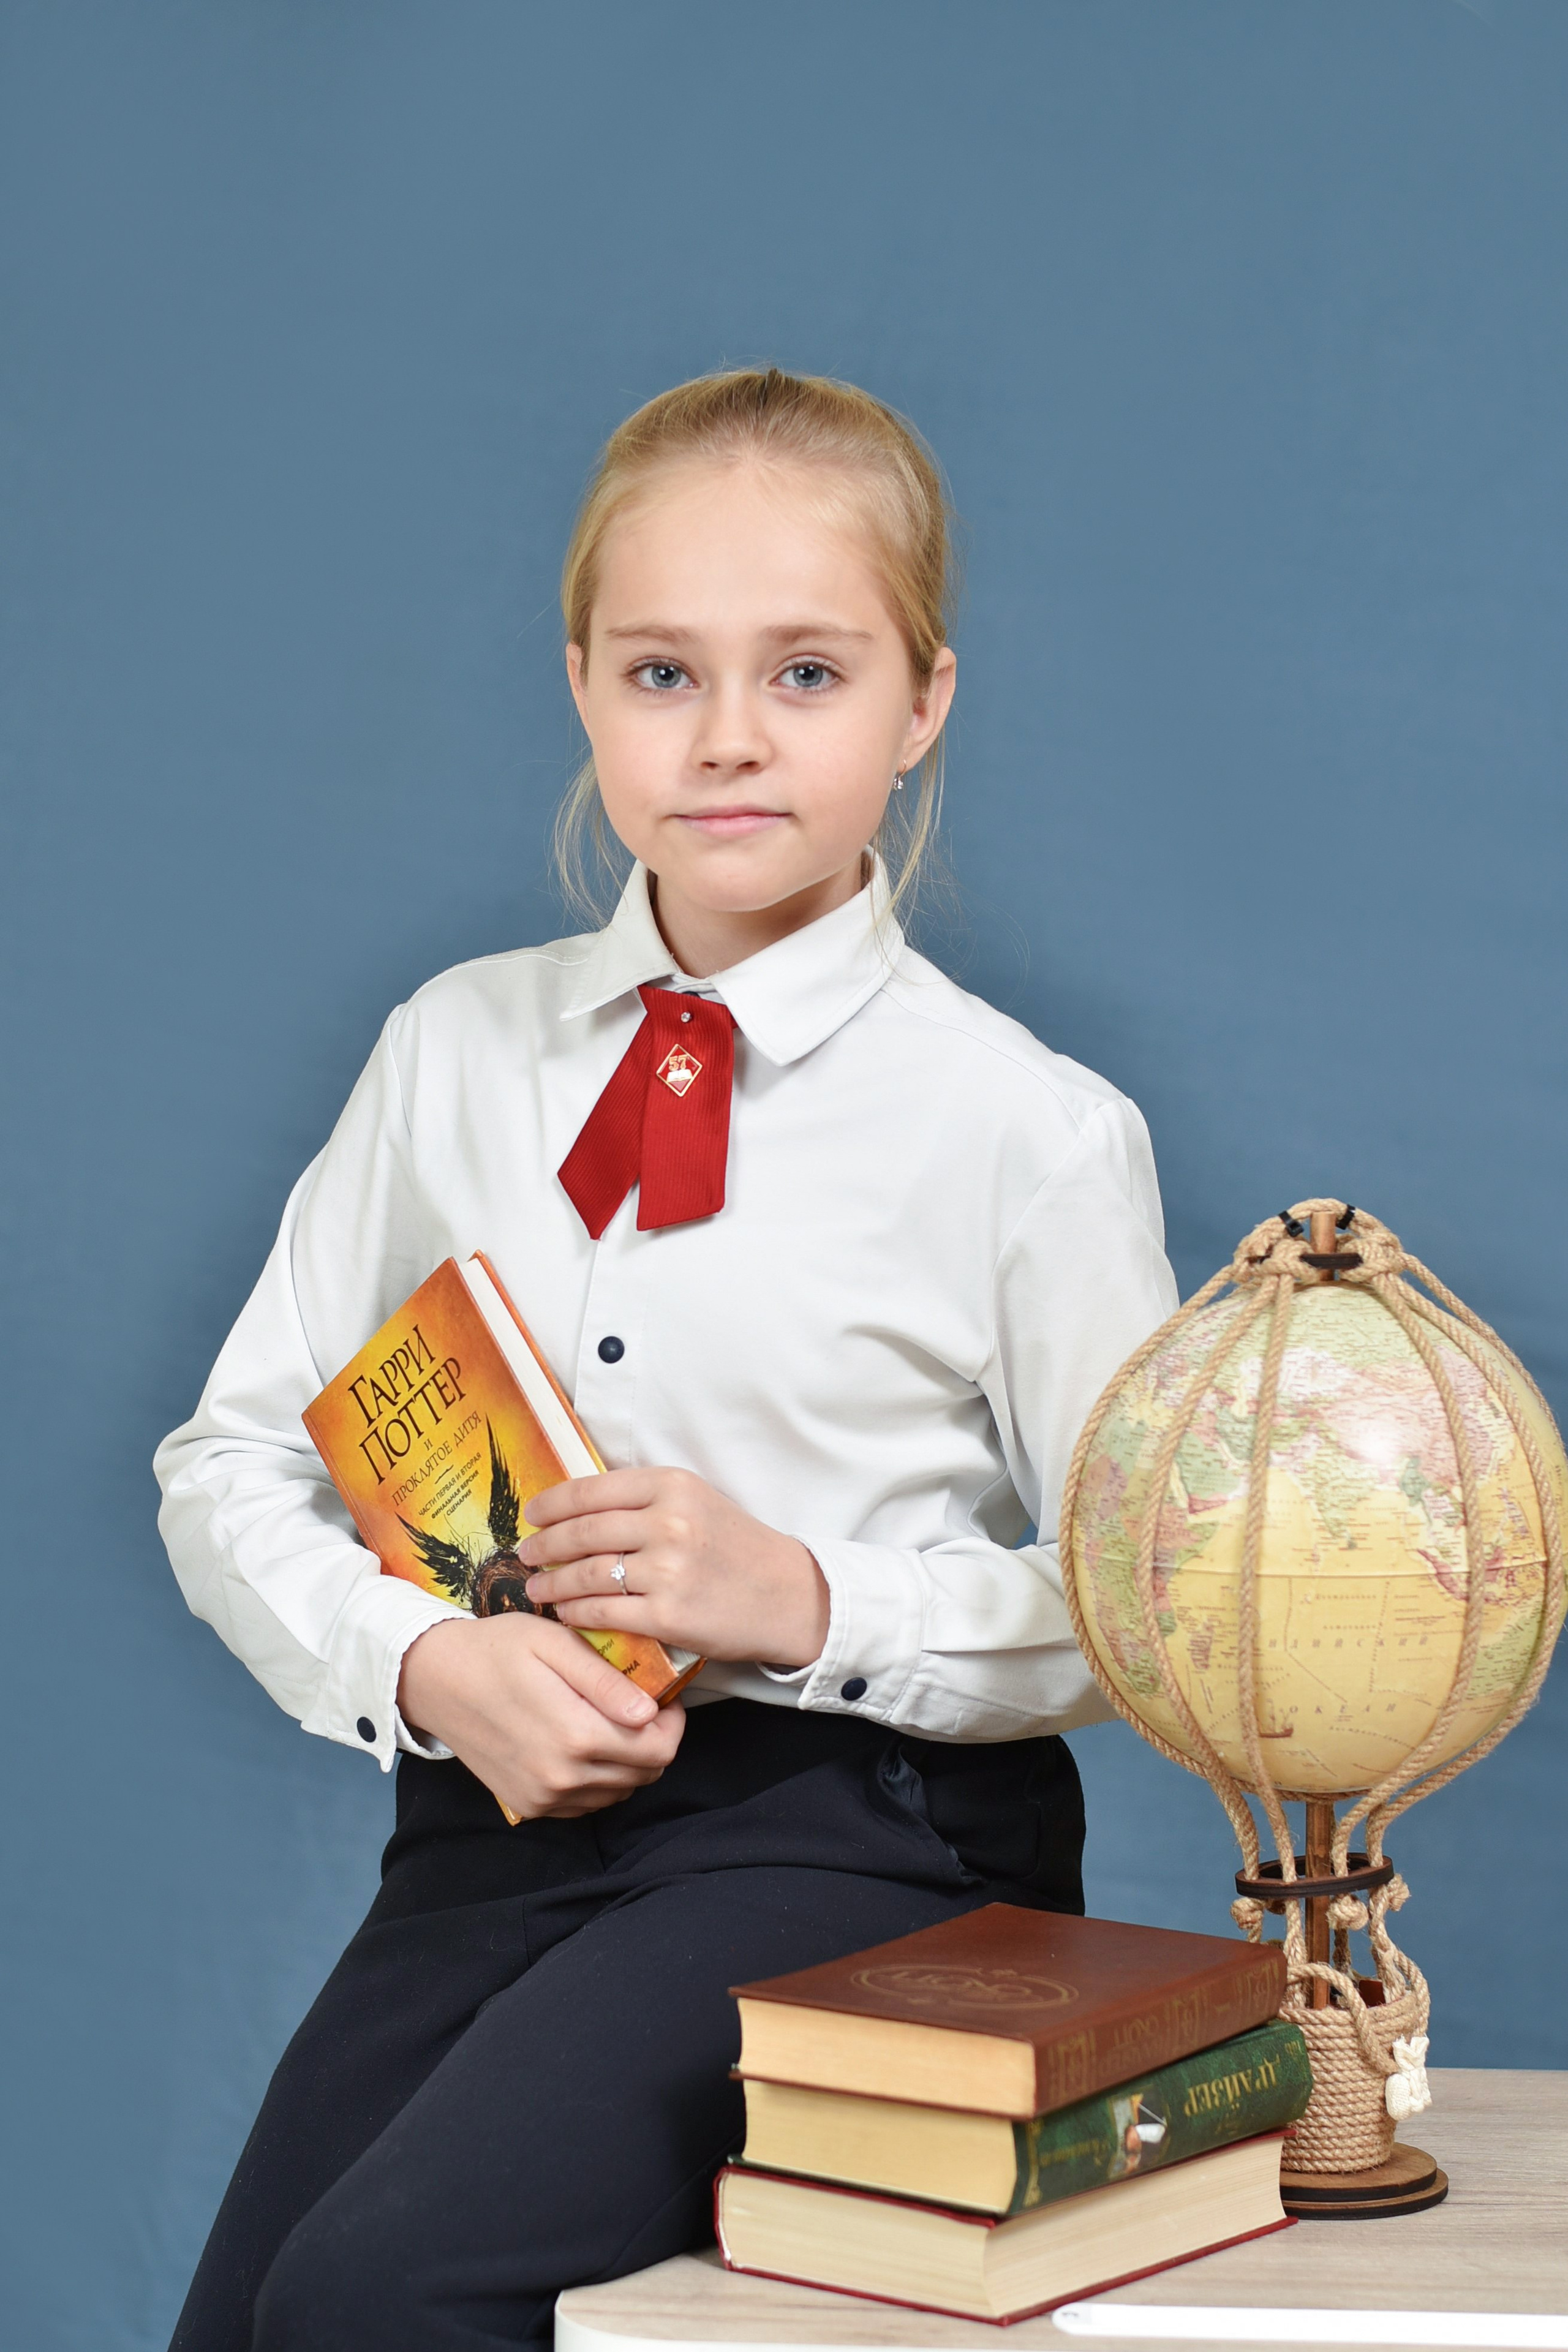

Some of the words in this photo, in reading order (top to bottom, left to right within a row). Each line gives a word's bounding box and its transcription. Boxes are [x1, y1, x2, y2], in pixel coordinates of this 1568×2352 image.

[668, 1054, 688, 1071] 57
[347, 1324, 435, 1429] ГАРРИ
[358, 1357, 466, 1486] ПОТТЕР
[424, 1438, 434, 1452] И
[391, 1440, 453, 1507] ПРОКЛЯТОЕ
[453, 1410, 483, 1448] ДИТЯ
[418, 1496, 438, 1516] ЧАСТИ
[435, 1477, 457, 1501] ПЕРВАЯ
[456, 1472, 462, 1480] И
[461, 1452, 482, 1477] ВТОРАЯ
[431, 1488, 462, 1520] ФИНАЛЬНАЯ
[461, 1469, 480, 1491] ВЕРСИЯ
[445, 1488, 473, 1516] СЦЕНАРИЯ
[622, 1659, 641, 1676] РНА
[1182, 2054, 1281, 2117] ДРАЙЗЕР
